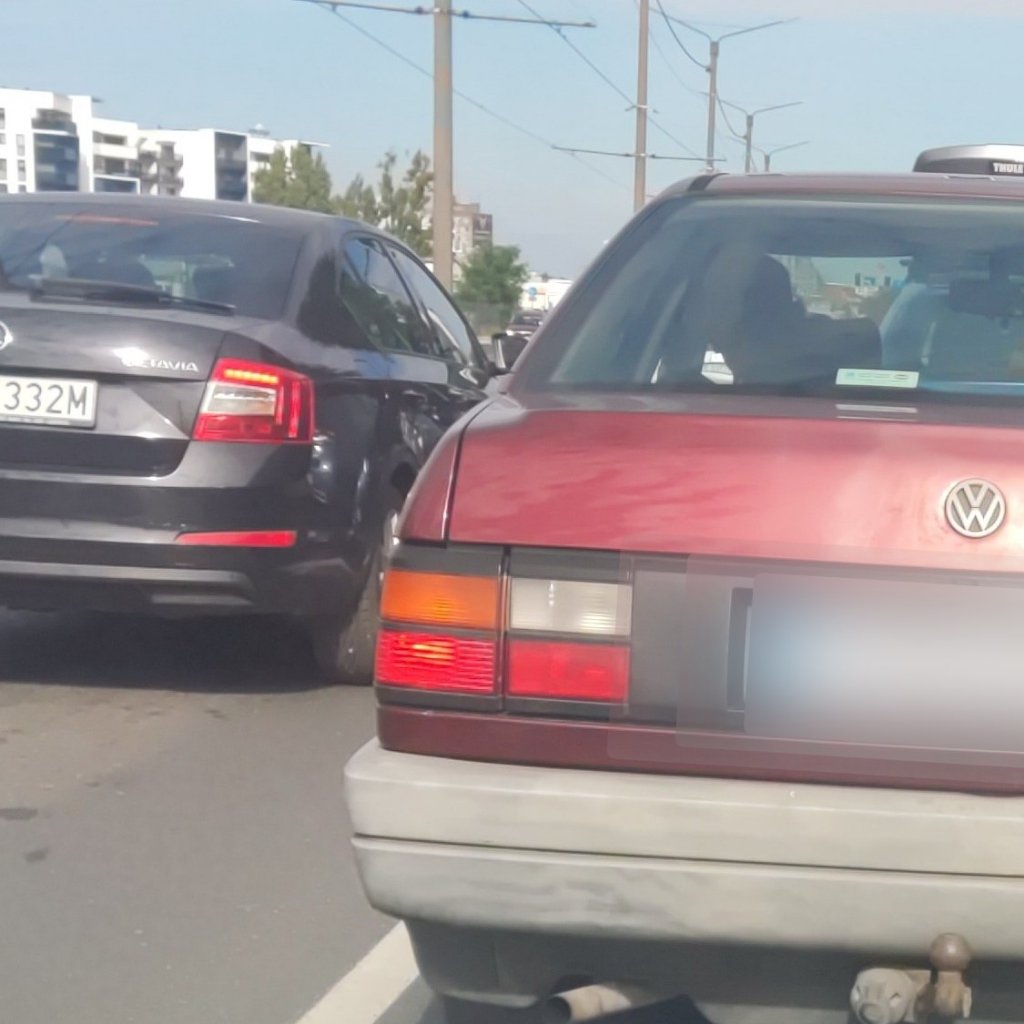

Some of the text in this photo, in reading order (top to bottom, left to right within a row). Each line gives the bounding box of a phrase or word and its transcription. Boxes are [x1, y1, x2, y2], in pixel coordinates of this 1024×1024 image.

[121, 355, 199, 372] TAVIA
[4, 382, 87, 416] 332M
[946, 478, 1006, 538] VW
